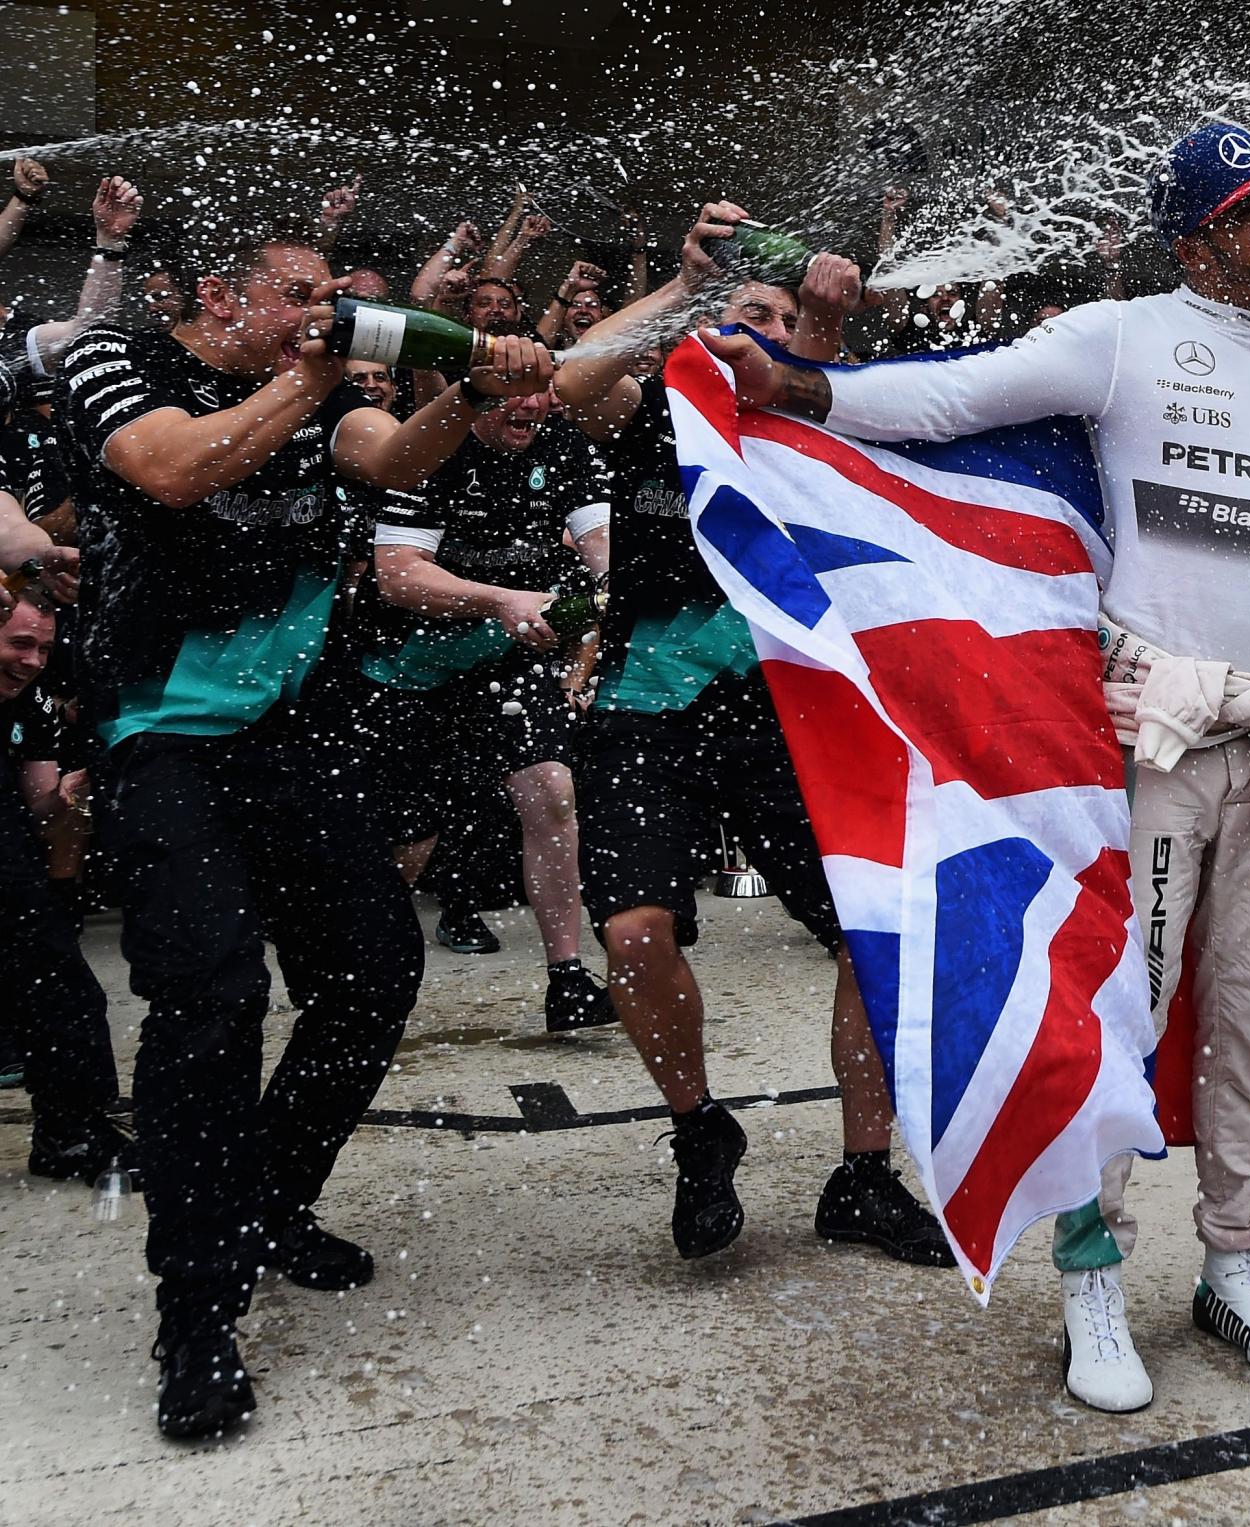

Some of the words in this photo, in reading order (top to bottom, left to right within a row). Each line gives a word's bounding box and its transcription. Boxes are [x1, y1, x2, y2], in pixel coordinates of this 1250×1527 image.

[64, 341, 127, 368] EPSON
[1172, 382, 1235, 399] BlackBerry
[1191, 406, 1232, 428] UBS
